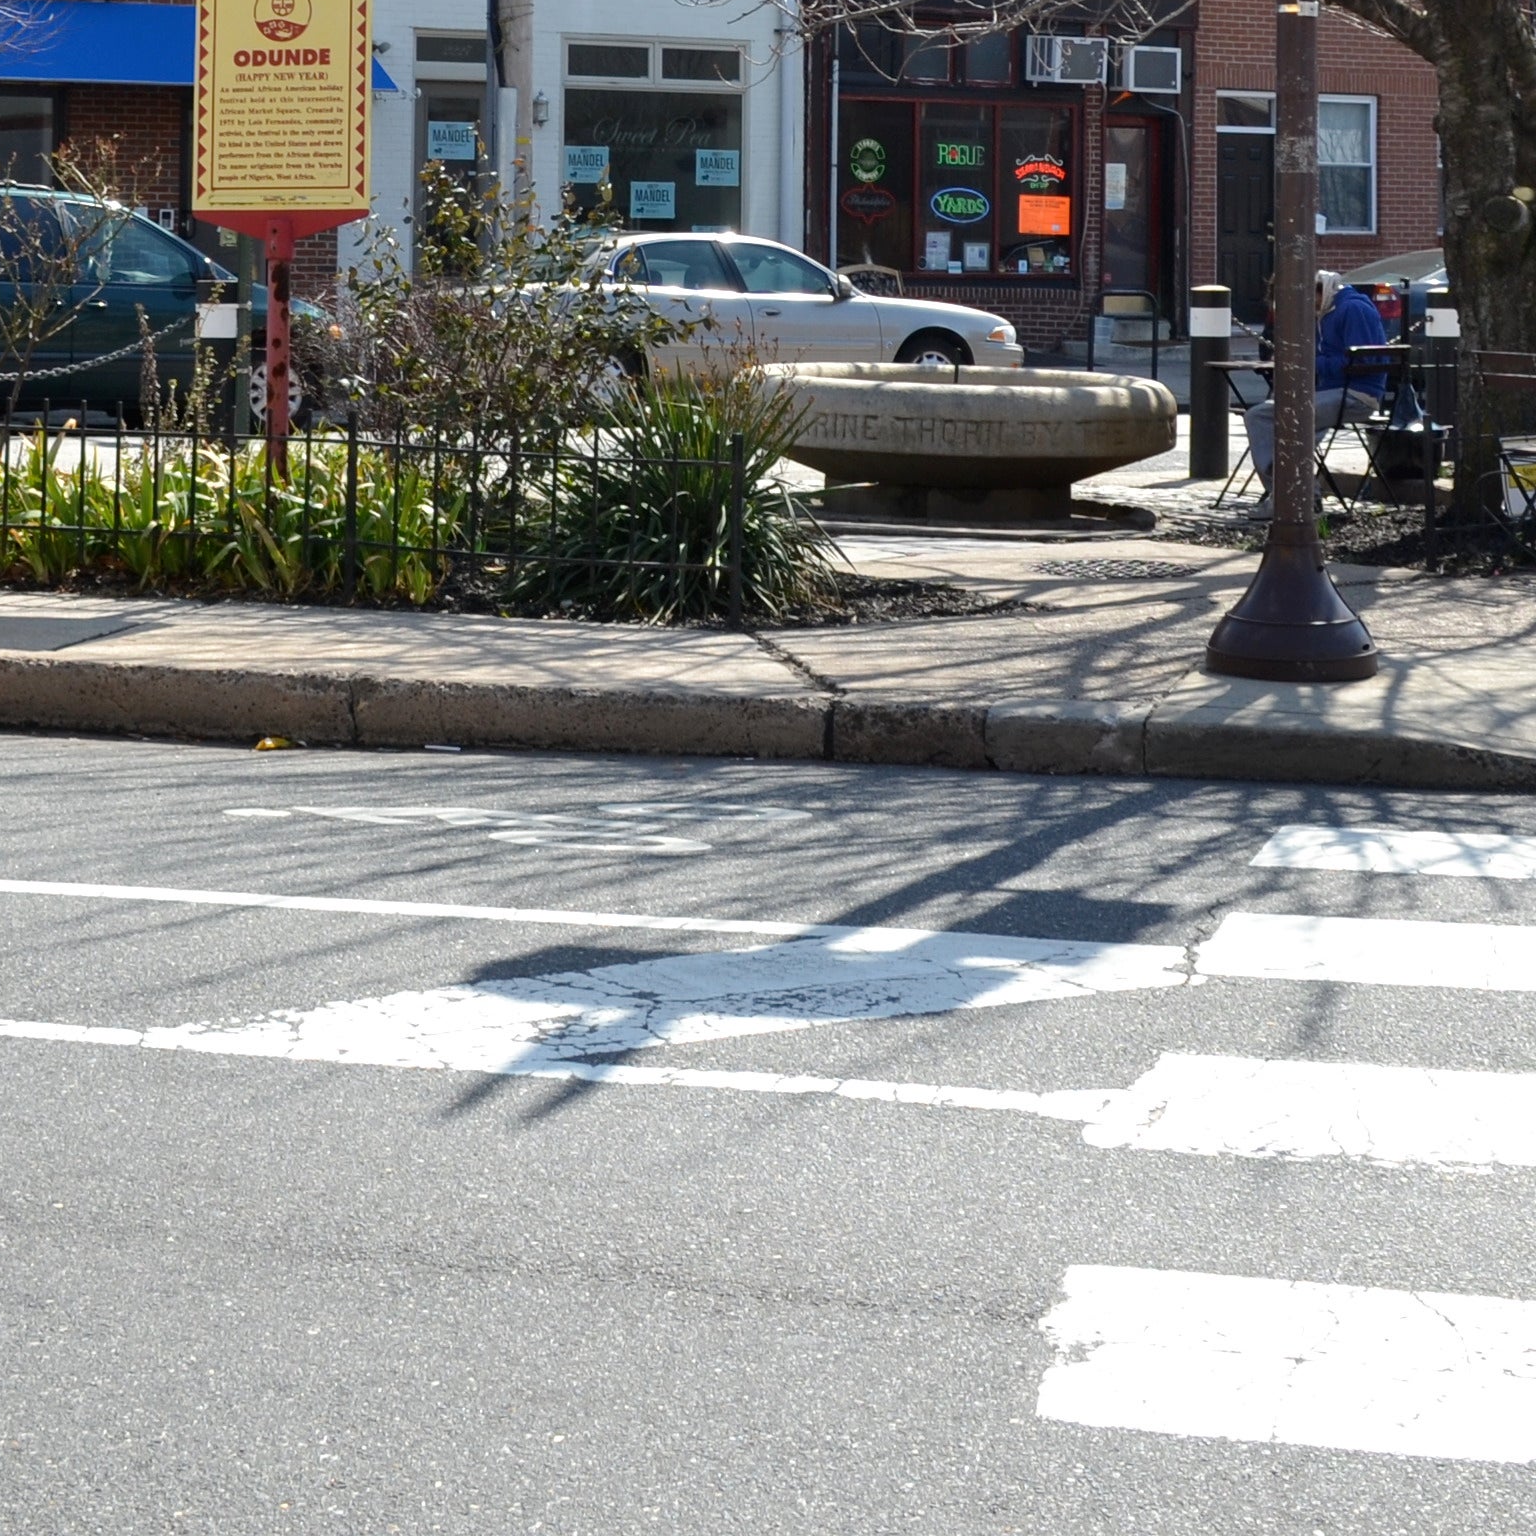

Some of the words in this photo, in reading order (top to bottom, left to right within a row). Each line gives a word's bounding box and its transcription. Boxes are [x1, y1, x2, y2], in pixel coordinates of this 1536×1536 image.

[233, 48, 331, 67] ODUNDE
[235, 73, 271, 83] (HAPPY
[273, 73, 295, 81] NEW
[299, 72, 328, 81] YEAR)
[432, 129, 471, 143] MANDEL
[568, 154, 605, 167] MANDEL
[937, 144, 985, 165] ROGUE
[700, 157, 734, 170] MANDEL
[634, 189, 671, 202] MANDEL
[936, 193, 986, 215] YARDS
